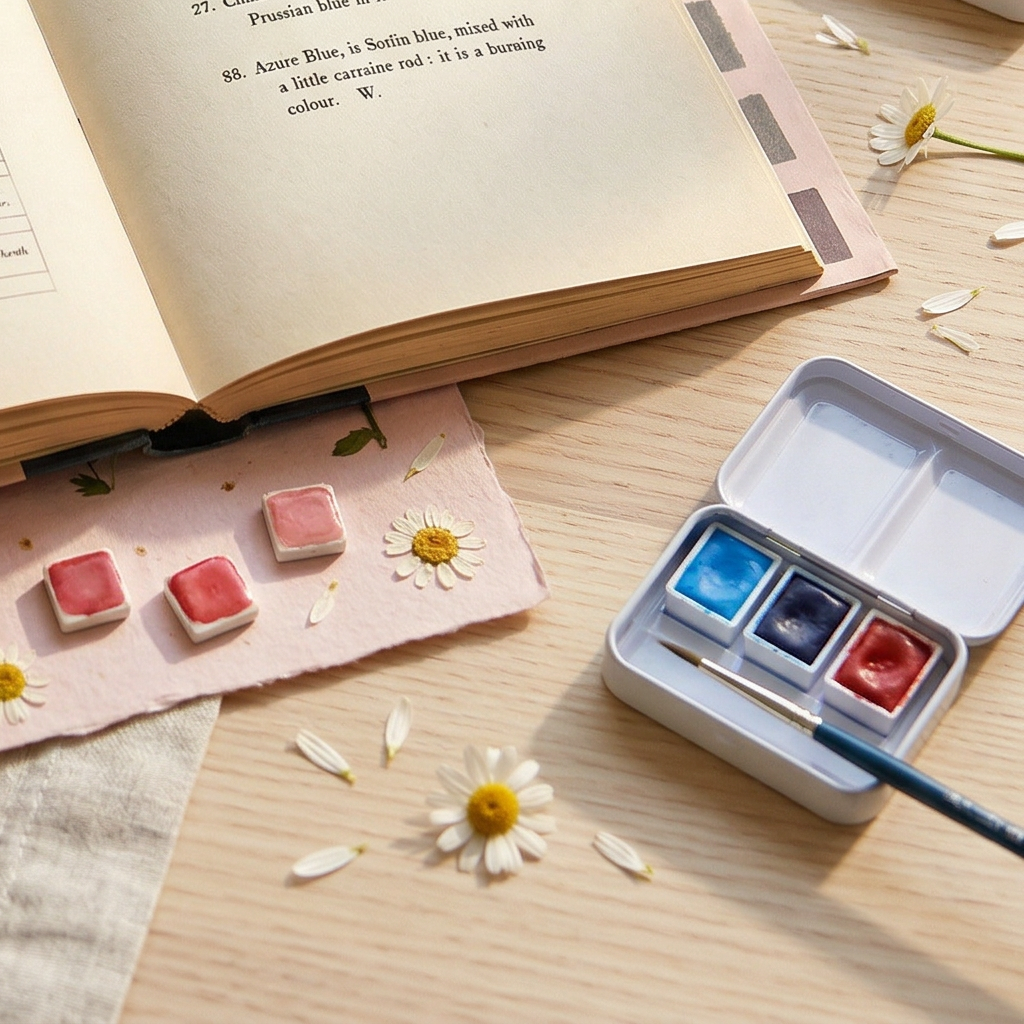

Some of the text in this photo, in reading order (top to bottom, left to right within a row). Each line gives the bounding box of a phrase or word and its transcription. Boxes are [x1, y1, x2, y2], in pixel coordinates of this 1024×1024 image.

[192, 0, 217, 16] 27.
[247, 4, 314, 27] Prussian
[254, 56, 300, 75] Azure
[302, 46, 345, 64] Blue,
[348, 41, 361, 55] is
[413, 27, 453, 44] blue,
[454, 19, 499, 38] mixed
[502, 14, 535, 30] with
[278, 83, 288, 93] a
[293, 72, 329, 91] little
[334, 61, 394, 82] carraine
[399, 54, 424, 70] rod
[439, 48, 451, 63] it
[456, 46, 469, 60] is
[474, 46, 484, 57] a
[287, 85, 381, 115] colour. W.
